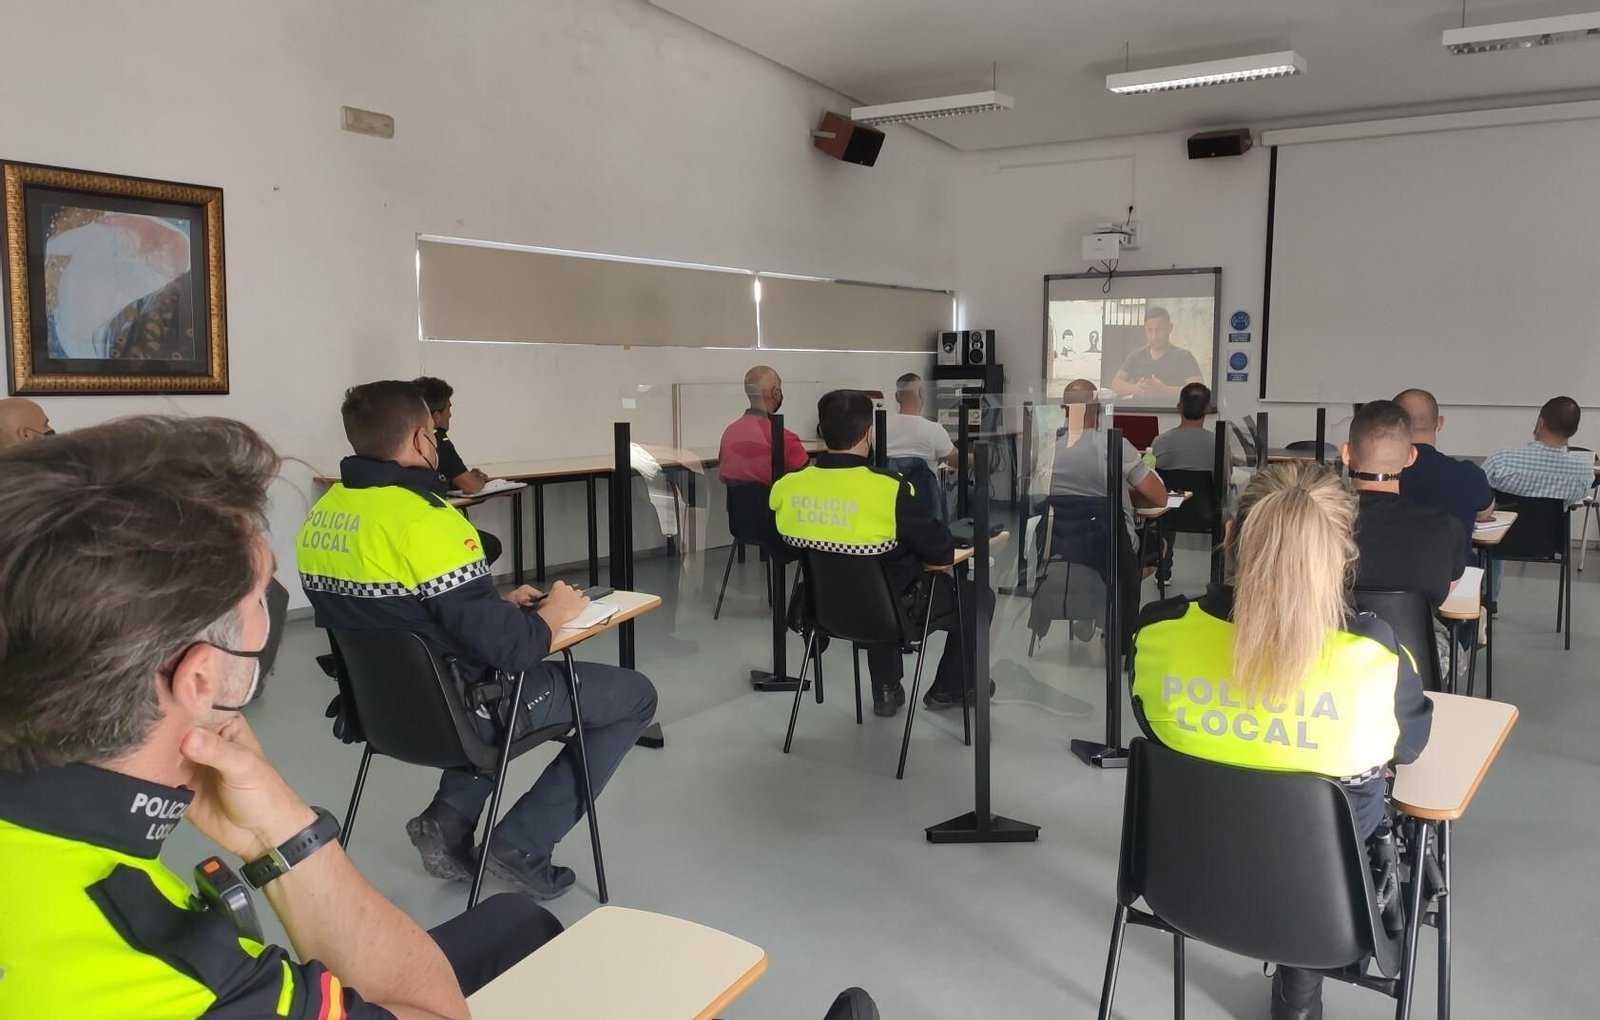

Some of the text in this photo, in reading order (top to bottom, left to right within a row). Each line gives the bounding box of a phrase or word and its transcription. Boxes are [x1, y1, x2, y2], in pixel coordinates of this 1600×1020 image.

[791, 496, 858, 514] POLICIA
[797, 510, 852, 529] LOCAL
[302, 530, 349, 553] LOCAL
[1176, 707, 1318, 749] LOCAL
